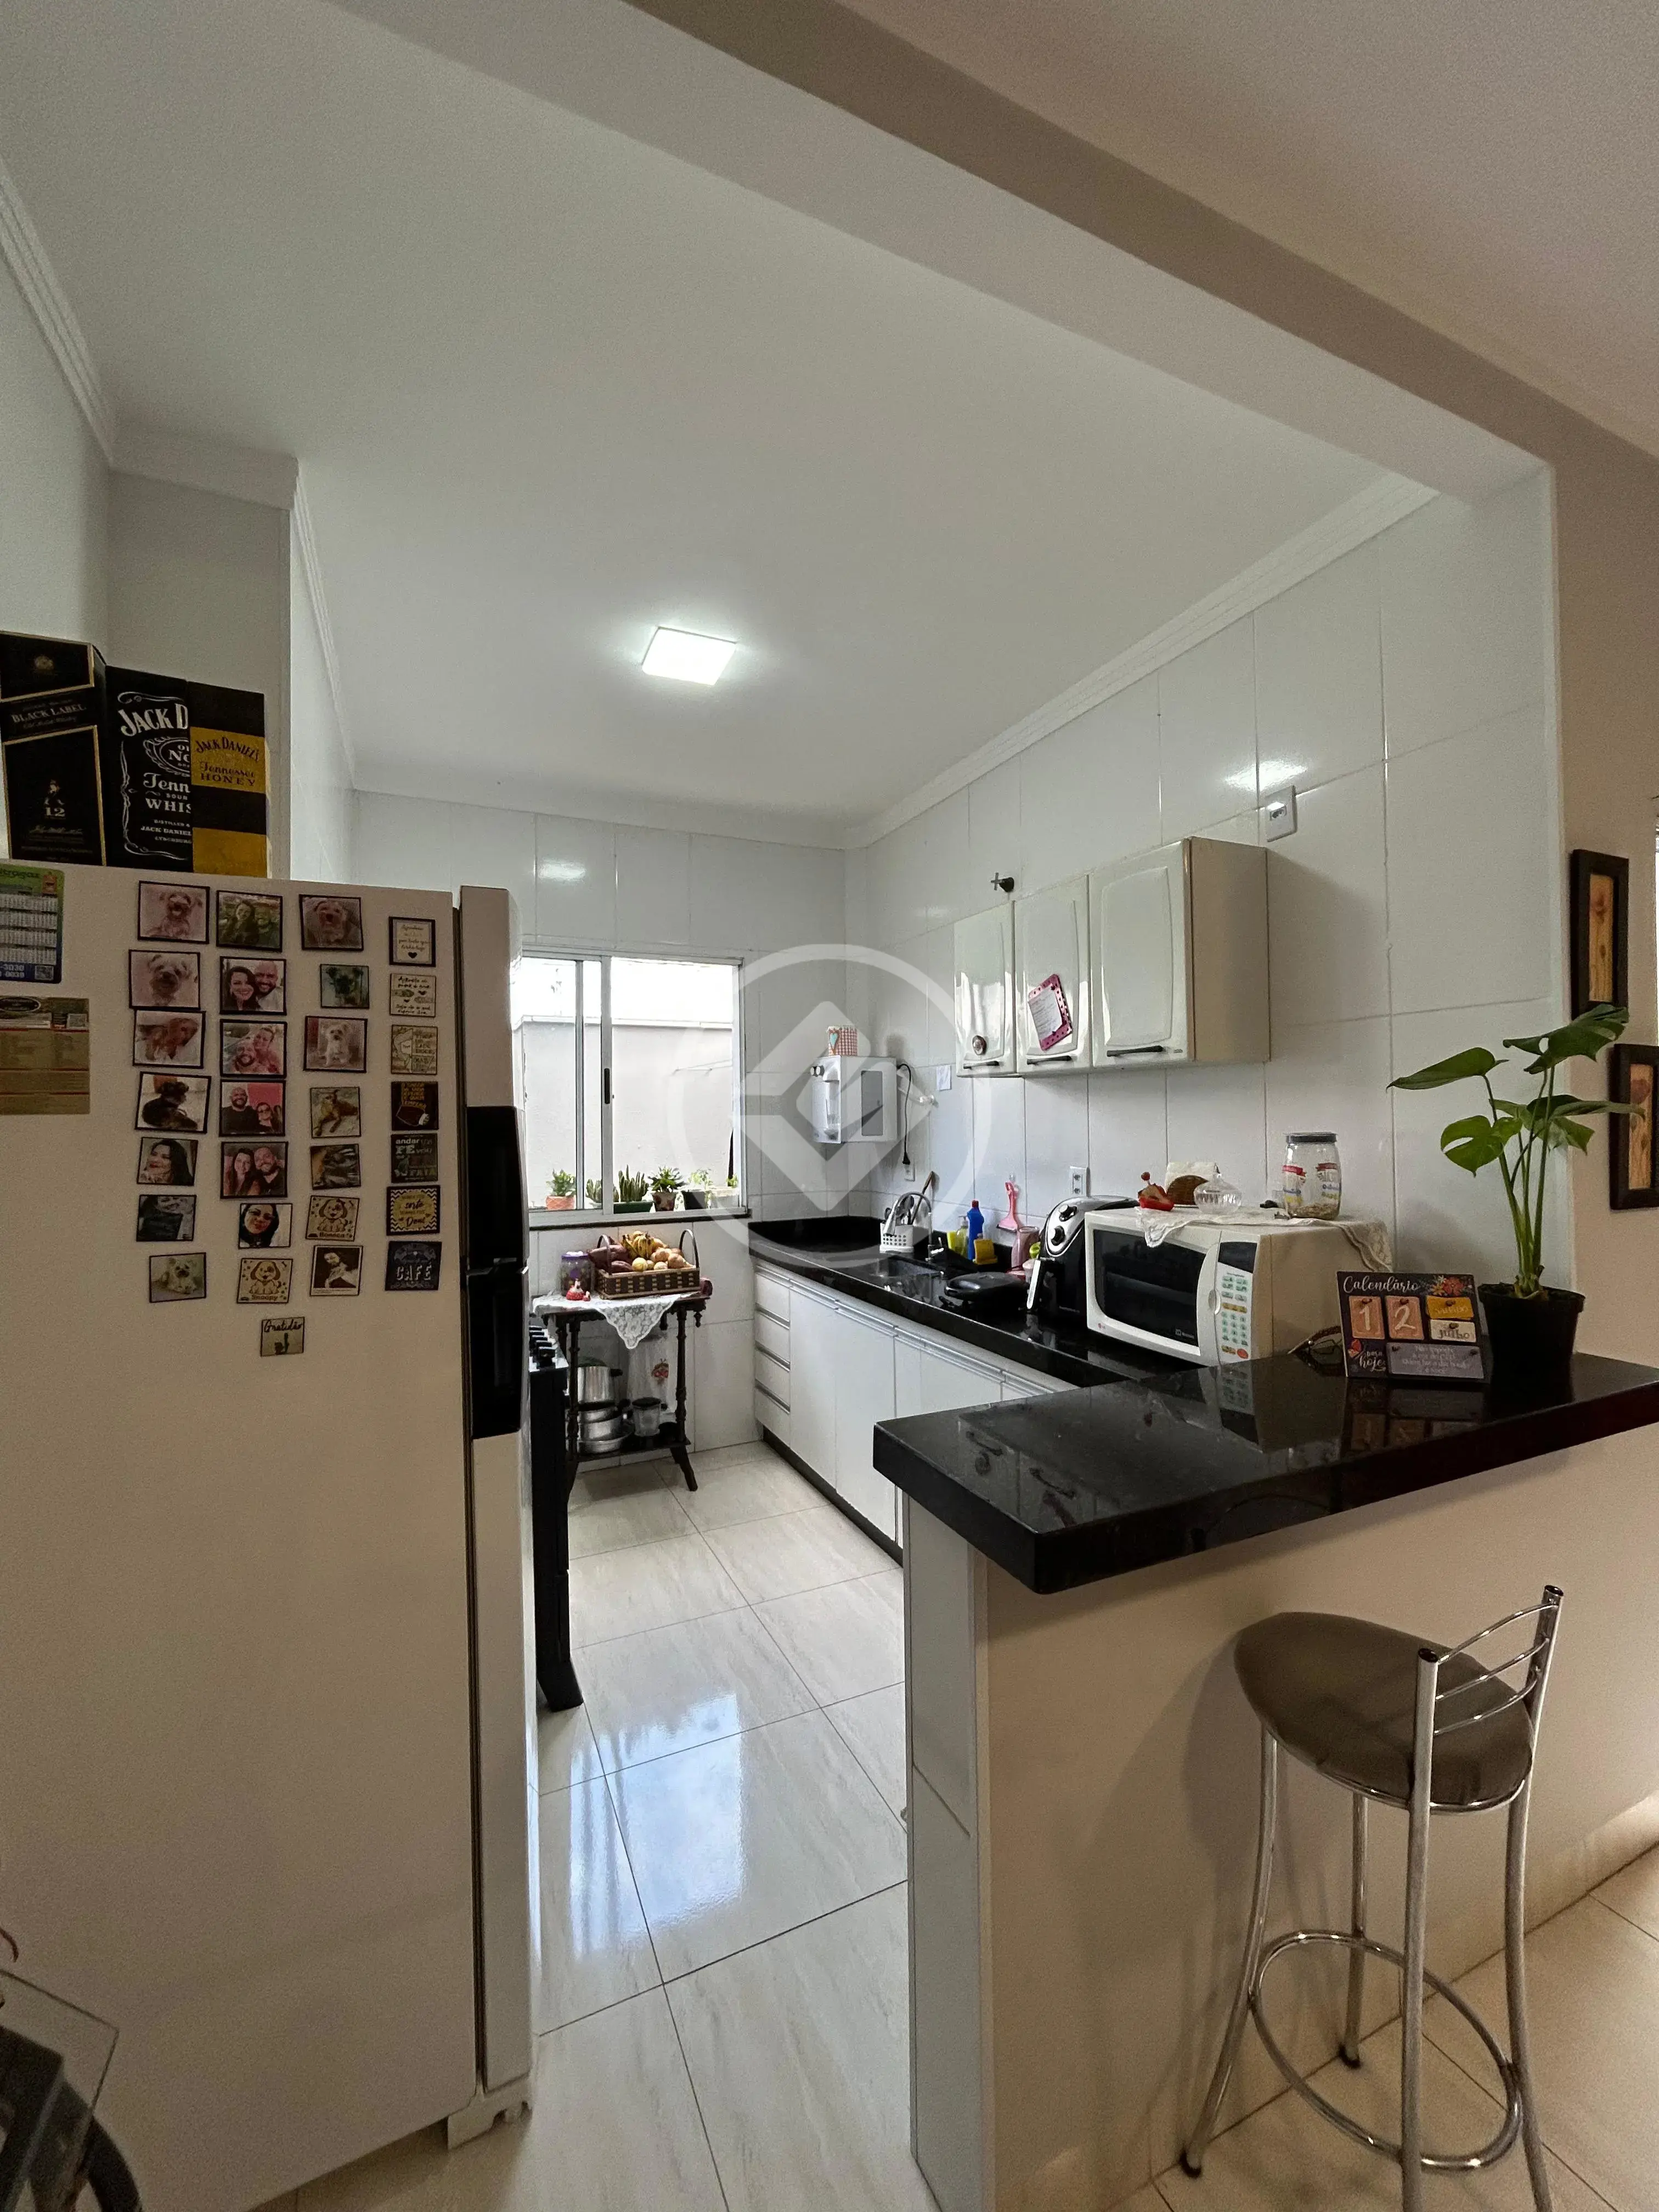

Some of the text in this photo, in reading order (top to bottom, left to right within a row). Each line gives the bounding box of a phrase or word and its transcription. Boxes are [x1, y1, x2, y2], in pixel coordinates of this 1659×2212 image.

[10, 710, 50, 724] BLACK
[50, 704, 86, 716] LABEL
[117, 708, 174, 737] JACK
[195, 739, 221, 753] JACK
[200, 761, 255, 777] Tennessee
[143, 772, 191, 793] Tenn
[201, 772, 256, 786] HONEY
[45, 807, 66, 816] 12
[1343, 1275, 1420, 1293] Calendário
[264, 1319, 303, 1333] Gratidão
[1359, 1305, 1416, 1330] 1 2
